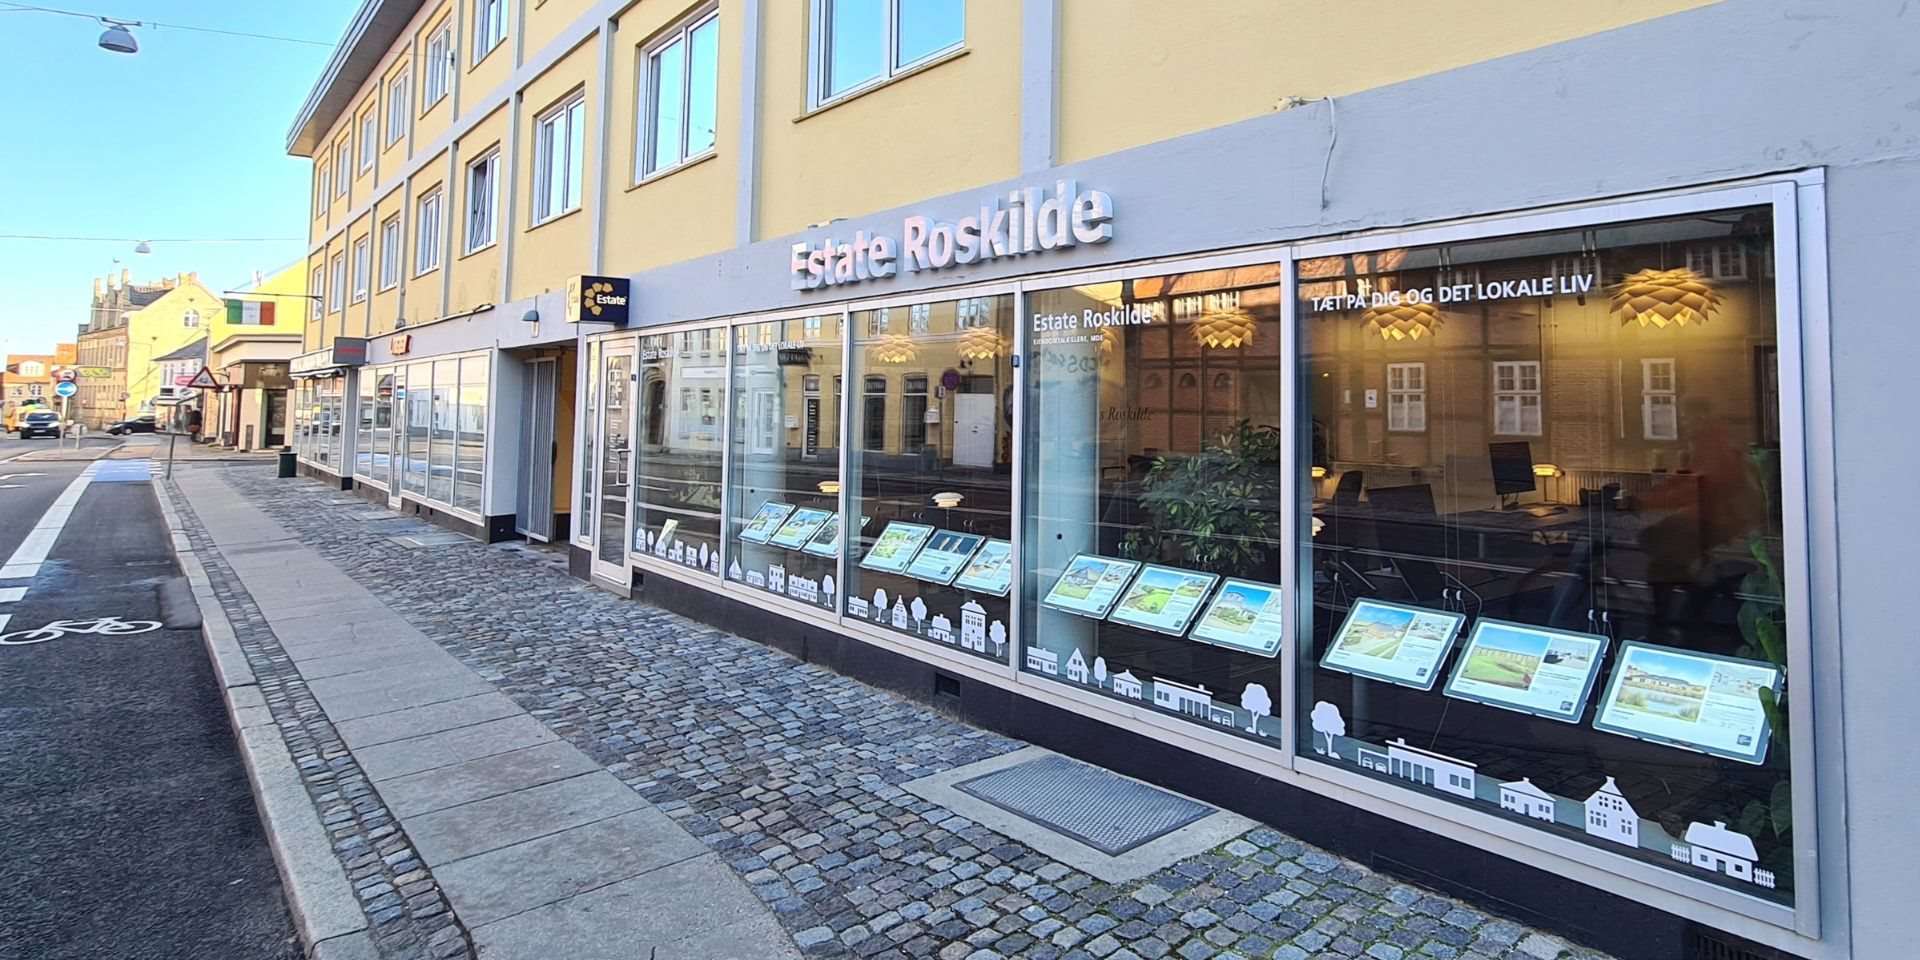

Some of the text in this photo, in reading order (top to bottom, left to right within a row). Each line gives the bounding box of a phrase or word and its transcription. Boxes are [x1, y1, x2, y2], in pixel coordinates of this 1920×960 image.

[791, 178, 1114, 291] Estate Roskilde
[596, 294, 627, 306] Estate
[1311, 296, 1341, 312] TÆT
[1371, 290, 1400, 308] DIG
[1406, 288, 1433, 305] OG
[1439, 284, 1473, 303] DET
[1477, 277, 1554, 300] LOKALE
[1560, 273, 1593, 294] LIV
[1033, 304, 1152, 332] Estate Roskilde
